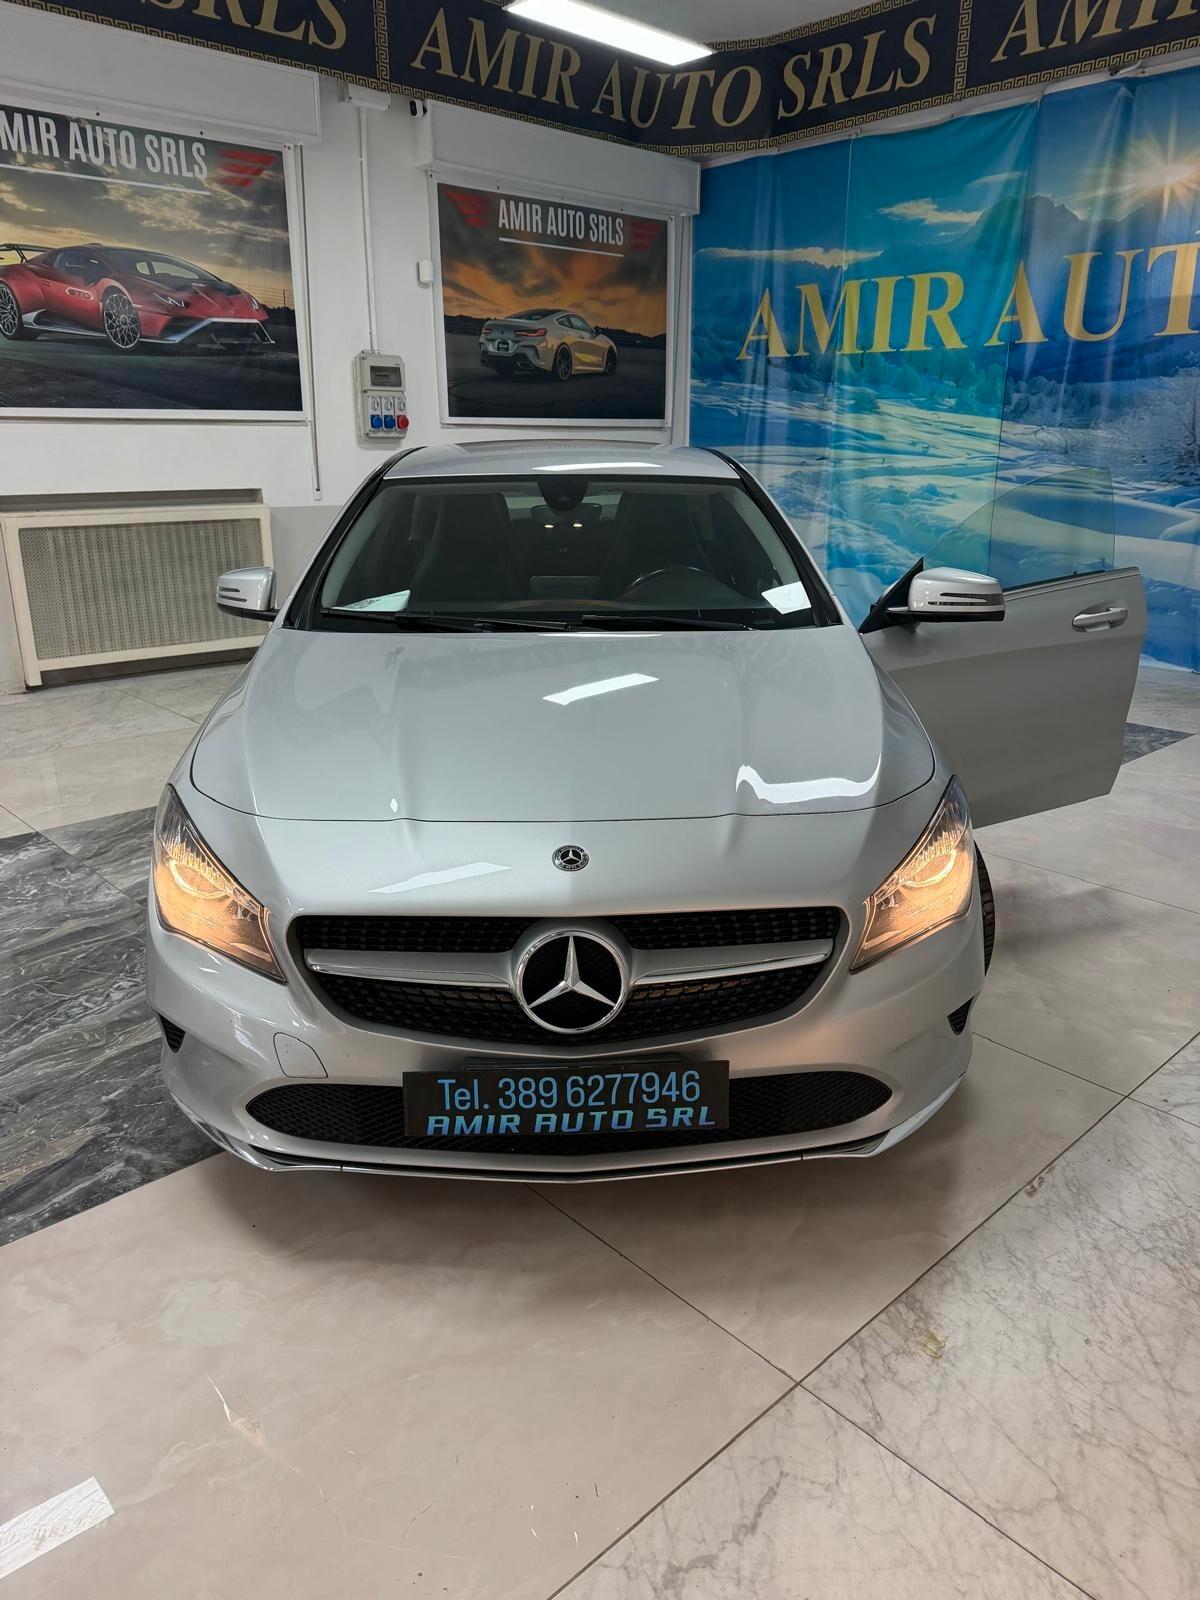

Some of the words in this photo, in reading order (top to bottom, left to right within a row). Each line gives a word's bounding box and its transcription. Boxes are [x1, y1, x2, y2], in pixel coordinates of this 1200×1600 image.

[410, 7, 580, 110] AMIR
[591, 59, 762, 130] AUTO
[777, 14, 937, 120] SRLS
[69, 121, 137, 170] AUTO
[144, 133, 208, 181] SRLS
[499, 198, 543, 234] AMIR
[547, 206, 585, 240] AUTO
[589, 213, 624, 246] SRLS
[737, 271, 966, 360] AMIR
[437, 1079, 490, 1111] Tel.
[498, 1077, 558, 1109] 389
[566, 1070, 701, 1107] 6277946
[426, 1114, 521, 1136] AMIR
[534, 1109, 634, 1132] AUTO
[645, 1106, 716, 1129] SRL
